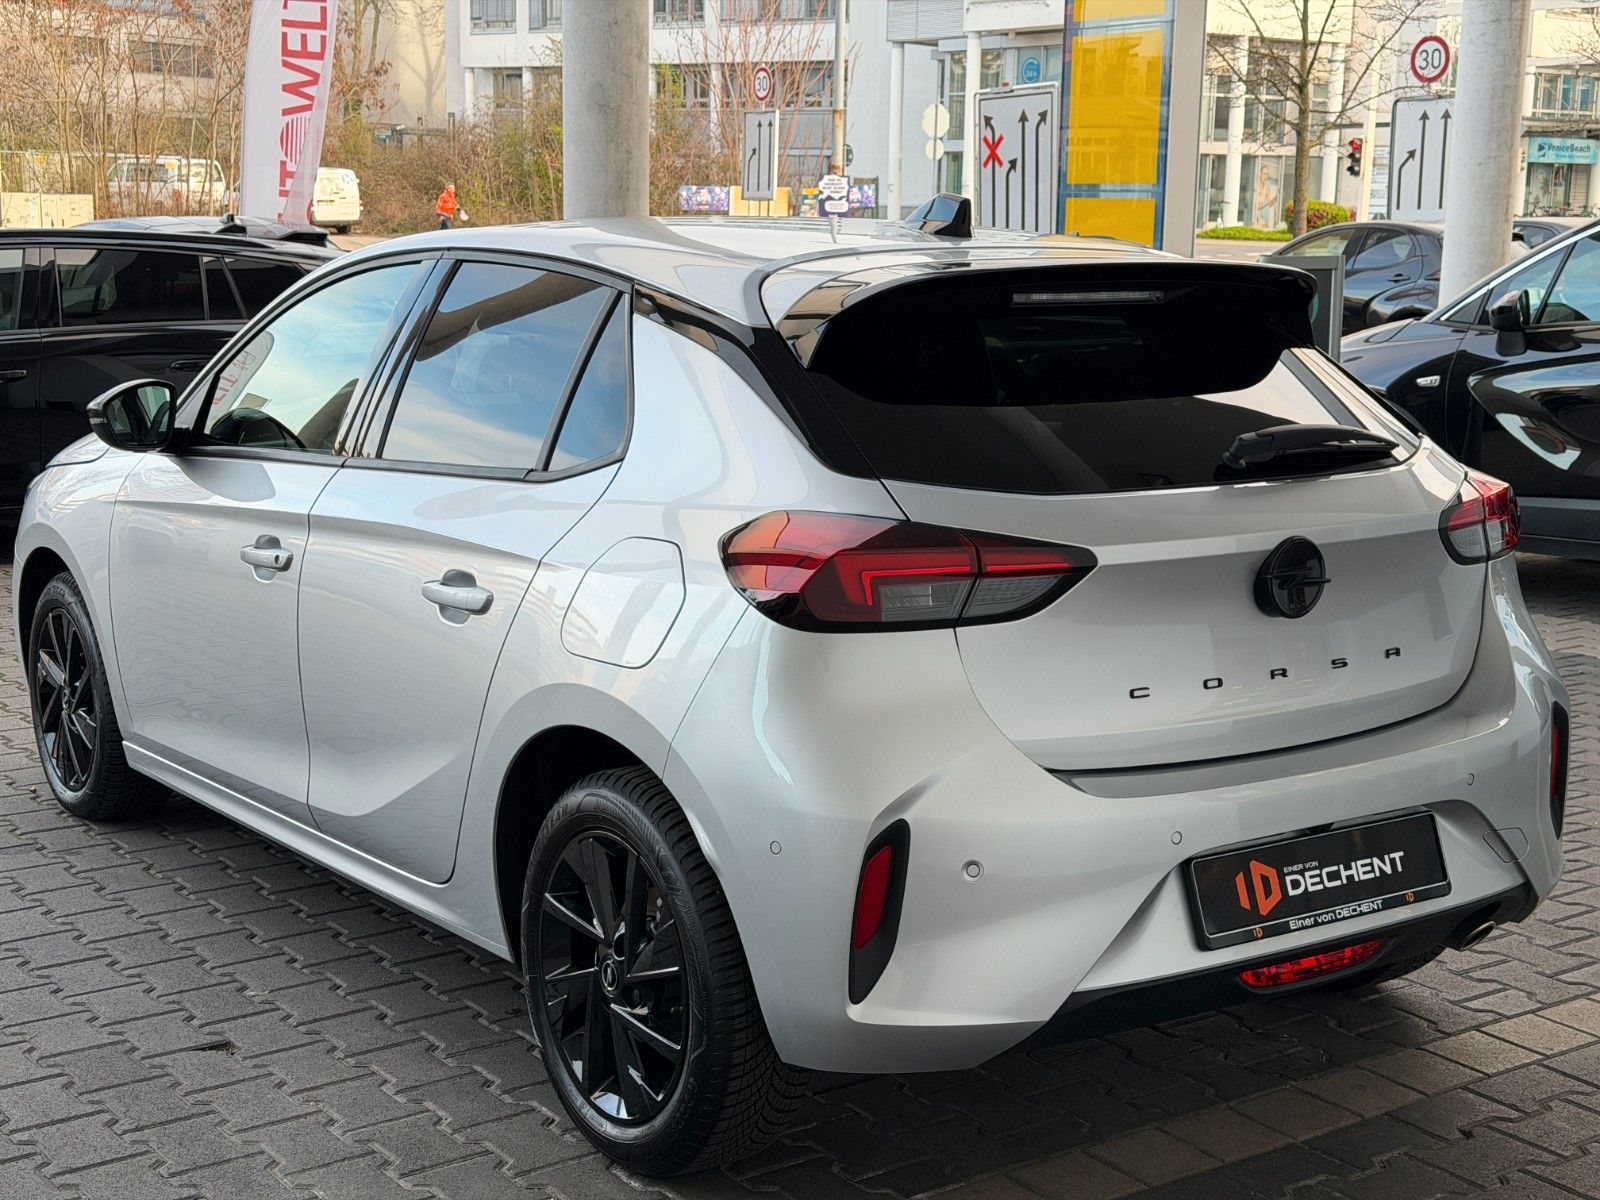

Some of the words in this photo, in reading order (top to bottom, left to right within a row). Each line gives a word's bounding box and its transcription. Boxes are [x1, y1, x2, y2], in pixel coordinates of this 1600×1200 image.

[1419, 48, 1441, 70] 30
[757, 76, 768, 91] 30
[1129, 647, 1401, 699] CORSA
[1283, 863, 1304, 874] EINER
[1304, 860, 1319, 868] VON
[1285, 851, 1405, 897] DECHENT
[1289, 918, 1315, 930] Einer
[1316, 911, 1336, 923] von
[1336, 900, 1383, 919] DECHENT
